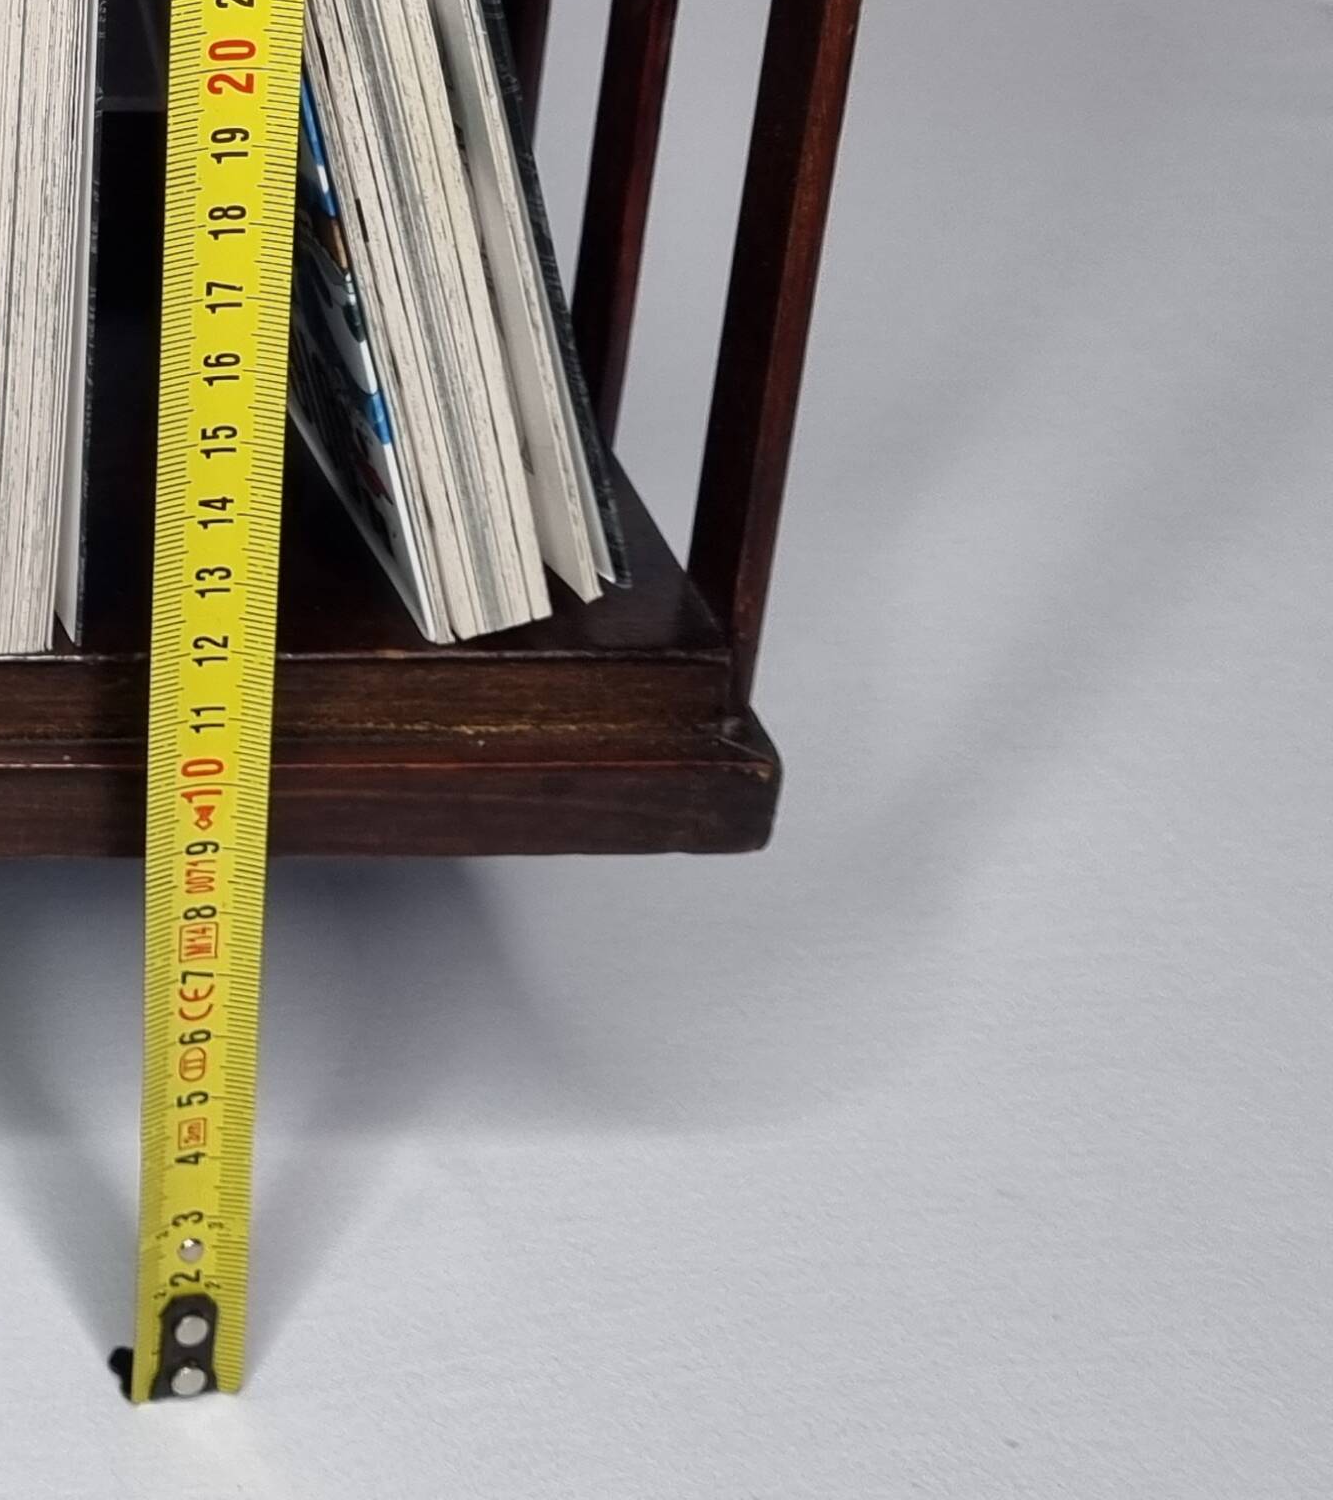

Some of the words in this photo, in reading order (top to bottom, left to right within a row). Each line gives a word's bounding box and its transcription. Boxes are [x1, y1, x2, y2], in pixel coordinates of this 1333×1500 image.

[205, 38, 258, 96] 20
[210, 127, 250, 165] 19
[207, 205, 247, 241] 18
[204, 281, 243, 314] 17
[202, 353, 241, 387] 16
[199, 425, 238, 460] 15
[197, 496, 235, 530] 14
[194, 566, 232, 599] 13
[192, 635, 229, 667] 12
[189, 706, 226, 734] 11
[180, 757, 225, 803] 10
[185, 840, 220, 856] 9
[182, 904, 218, 921] 8
[180, 970, 214, 985] 7
[178, 1029, 212, 1046] 6
[175, 1090, 209, 1109] 5
[174, 1151, 207, 1166] 4
[171, 1210, 204, 1228] 3
[168, 1269, 202, 1288] 2
